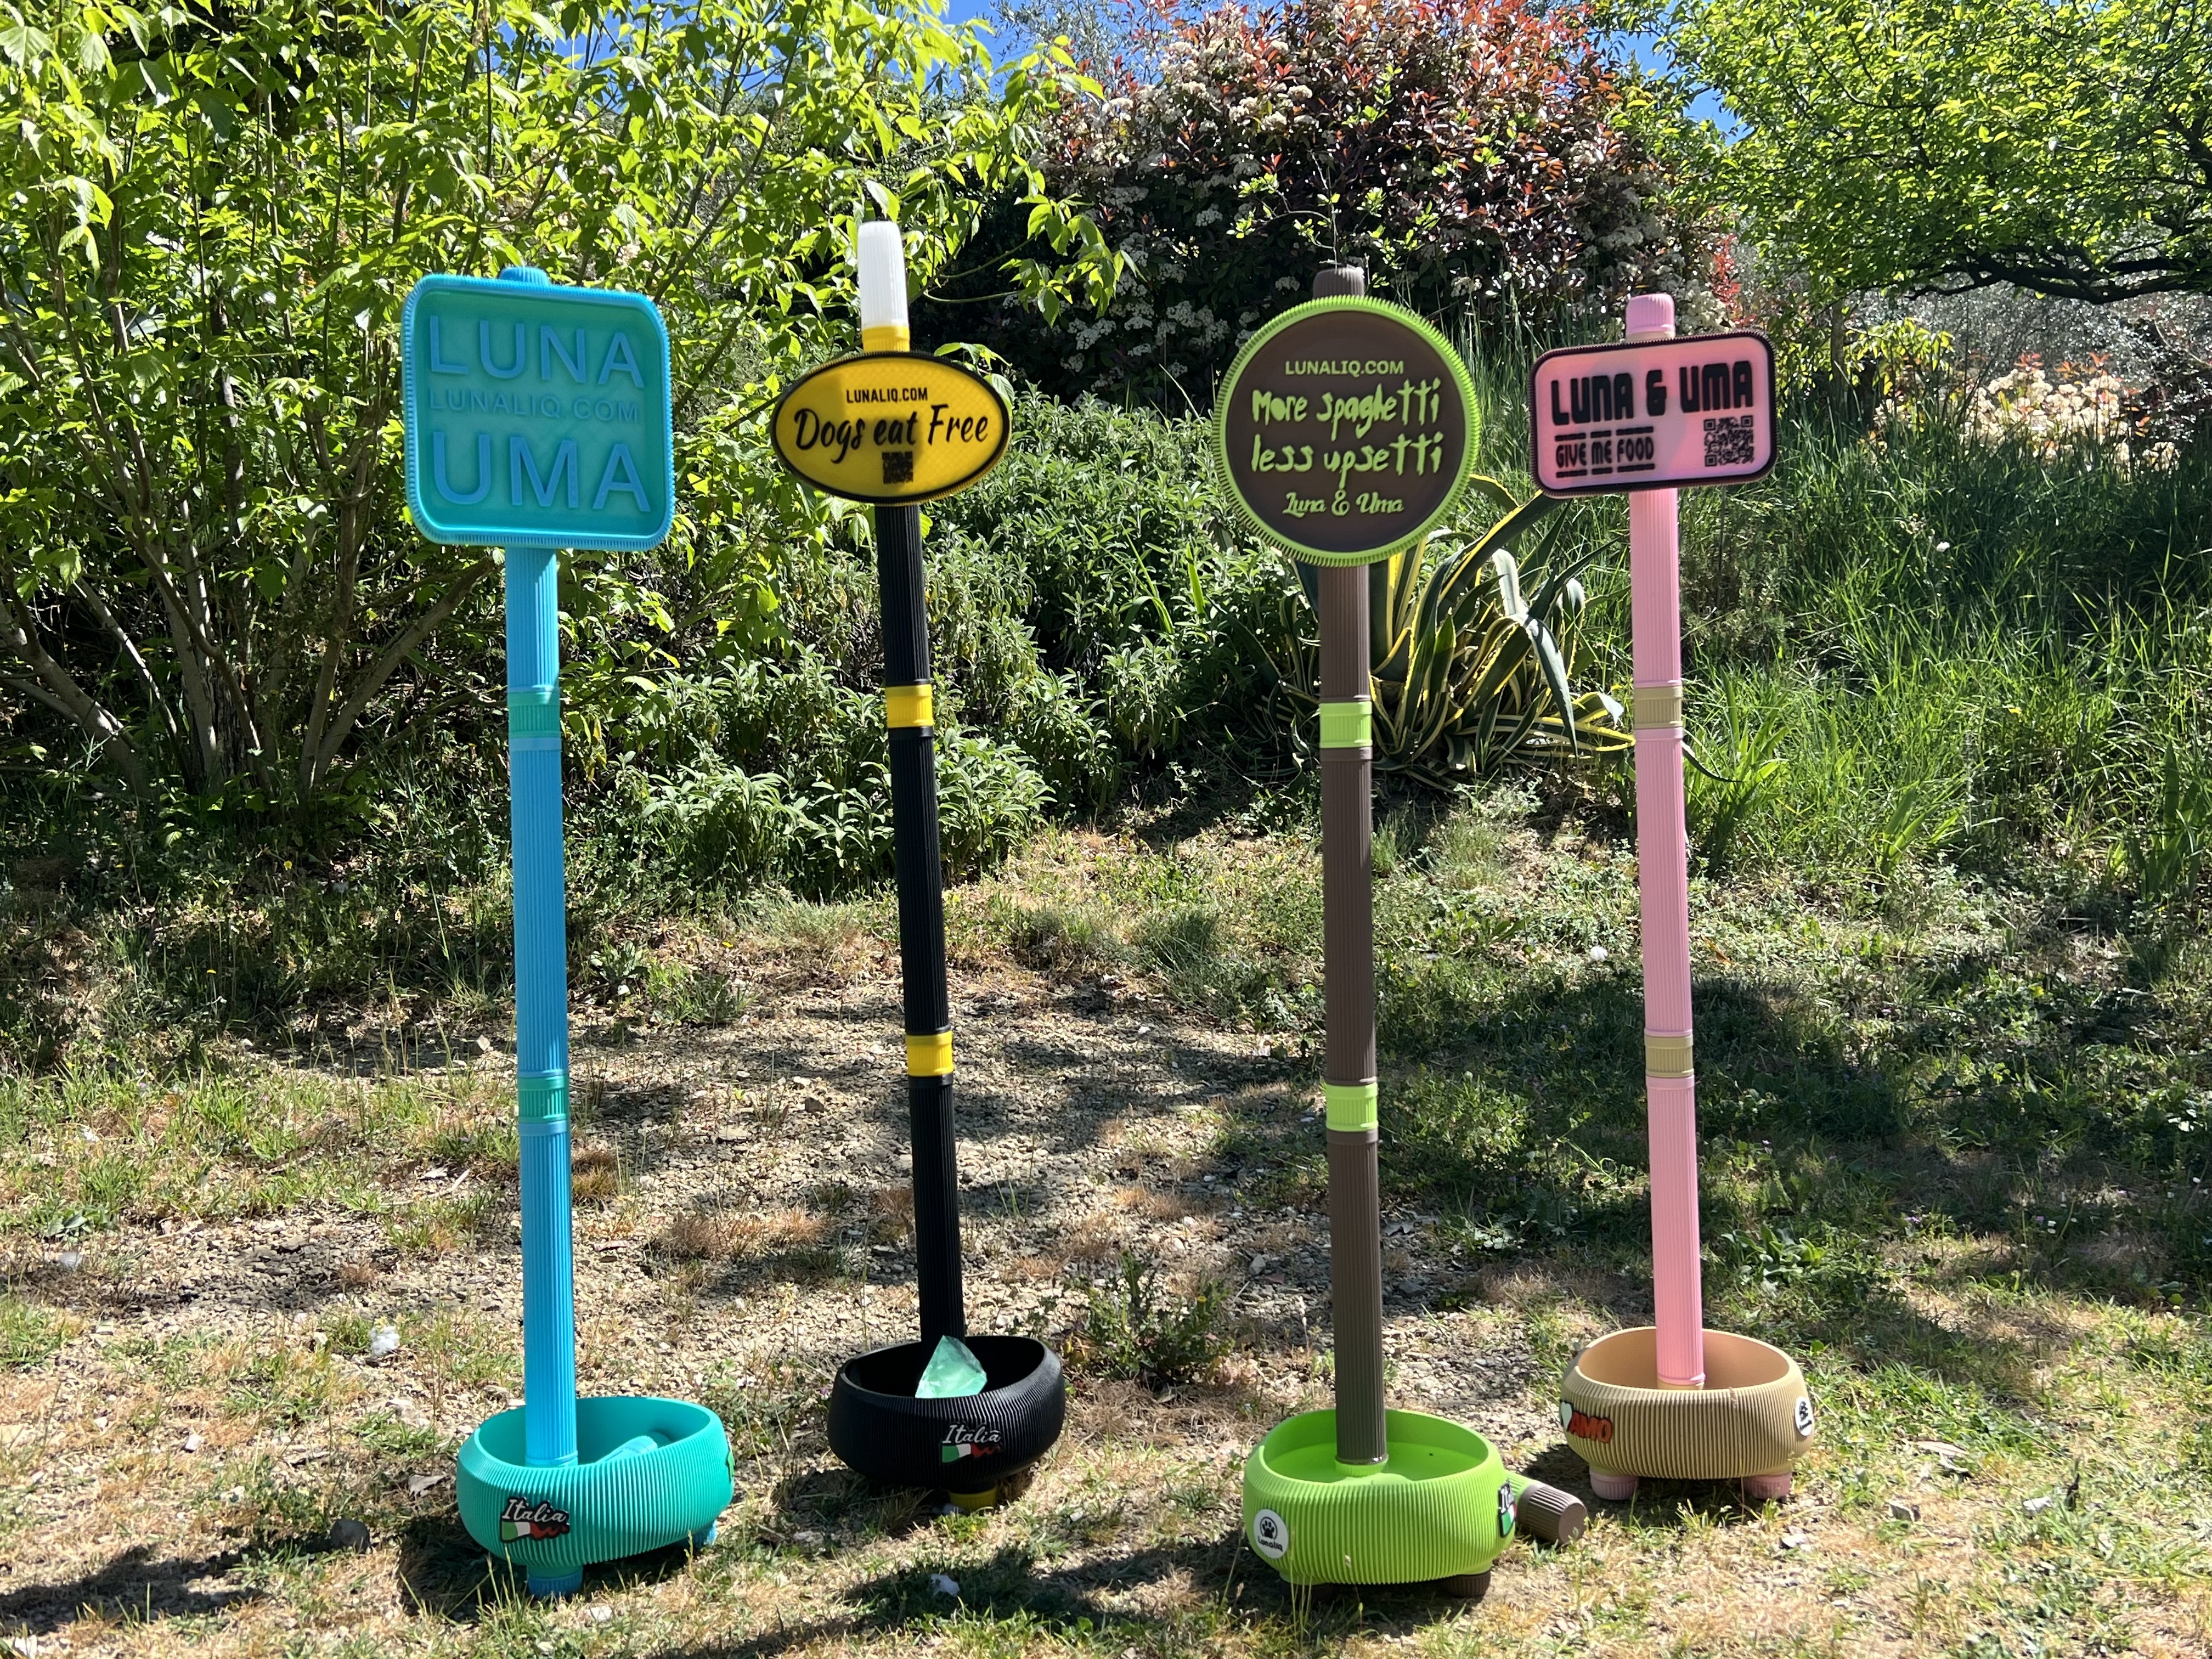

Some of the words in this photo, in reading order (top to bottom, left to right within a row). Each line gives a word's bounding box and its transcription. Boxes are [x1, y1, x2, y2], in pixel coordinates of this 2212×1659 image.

[430, 315, 645, 388] LUNA
[1285, 360, 1404, 377] LUNALIQ.COM
[847, 387, 928, 403] LUNALIQ.COM
[1251, 389, 1308, 426] More
[1550, 373, 1634, 426] LUNA
[1646, 369, 1667, 416] &
[1679, 360, 1754, 413] UMA
[794, 408, 865, 464] Dogs
[873, 411, 918, 445] eat
[928, 403, 988, 445] Free
[1251, 433, 1314, 473] less
[1323, 431, 1444, 490] upsetti
[1555, 442, 1587, 469] GIVE
[1591, 440, 1612, 465] ME
[1617, 437, 1654, 463] FOOD
[433, 431, 651, 512] UMA
[1282, 492, 1327, 518] Luna
[1331, 489, 1350, 516] &
[1356, 492, 1404, 515] Uma
[942, 1424, 1002, 1444] Italia
[502, 1498, 567, 1523] Italia
